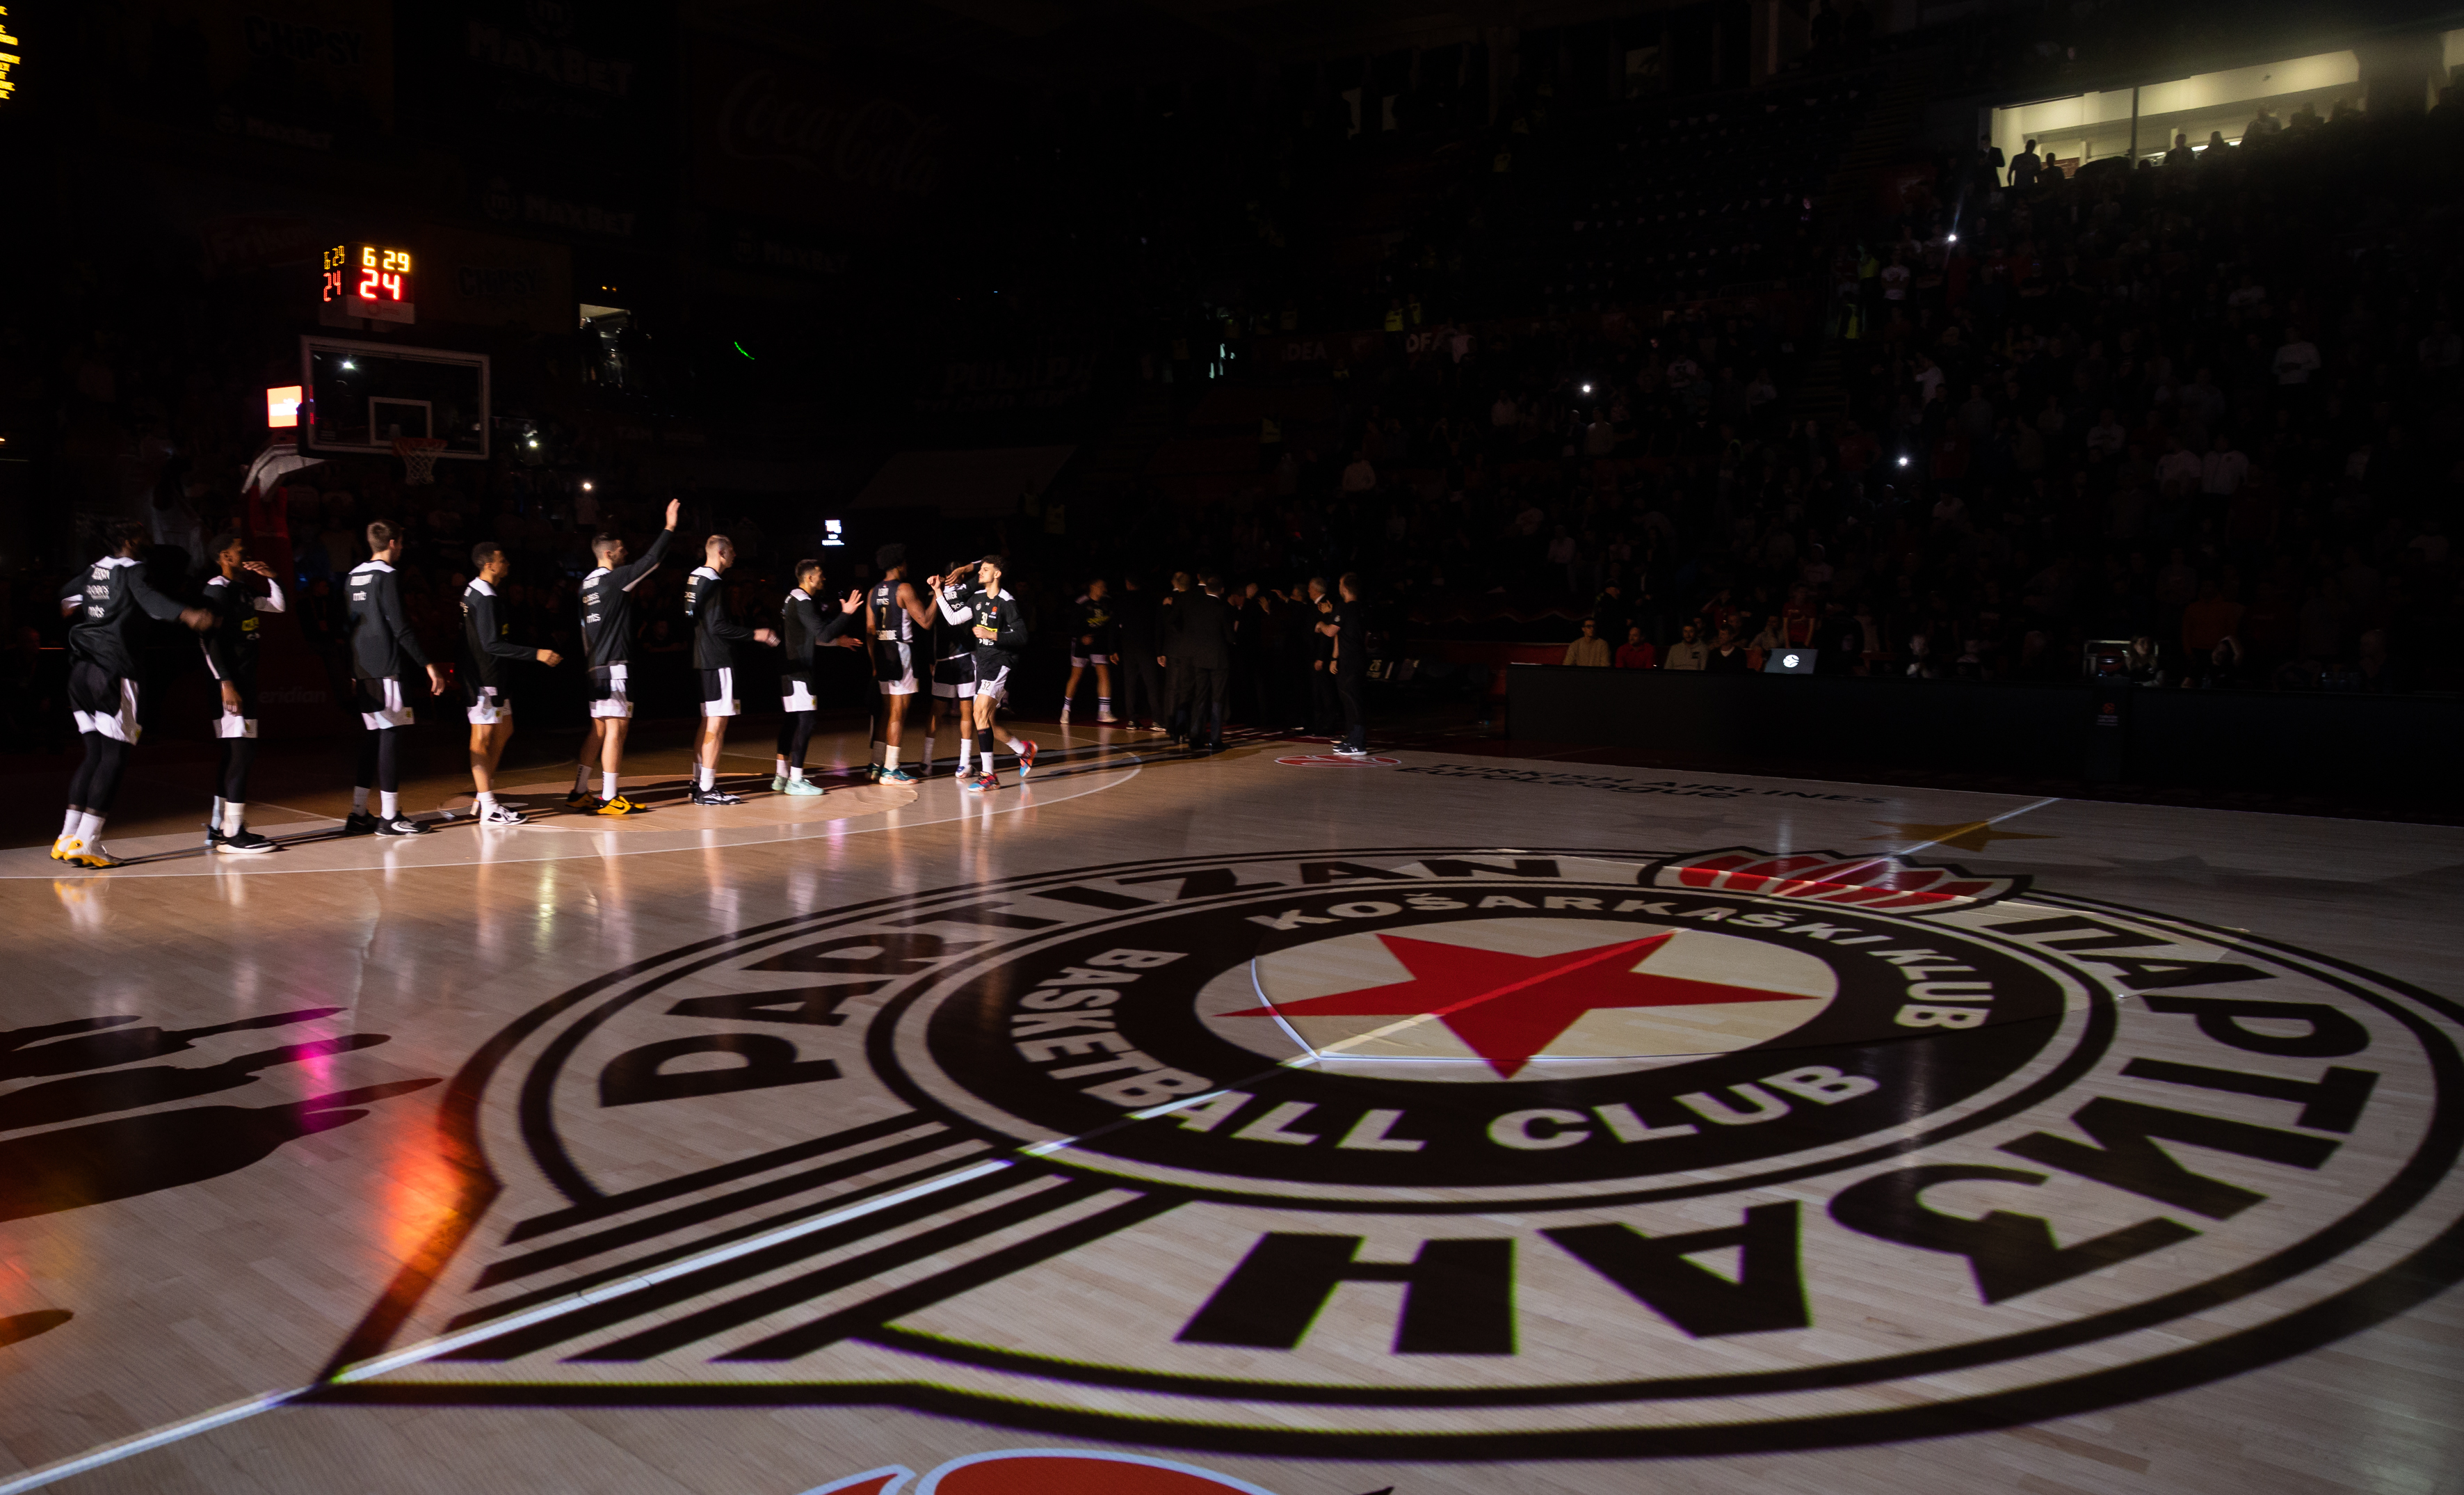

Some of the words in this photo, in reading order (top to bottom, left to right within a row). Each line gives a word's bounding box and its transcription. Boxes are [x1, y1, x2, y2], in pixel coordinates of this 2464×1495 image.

[716, 67, 949, 198] Coca-Cola
[323, 270, 341, 302] 24
[360, 268, 401, 300] 24
[363, 246, 376, 267] 6
[383, 250, 410, 272] 29
[1641, 781, 1893, 804] AIRLINES
[599, 856, 1561, 1108] PARTIZAN
[1245, 891, 1895, 946] KOŠARKAŠKI
[1865, 948, 1996, 1030] KLUB
[1008, 946, 1427, 1152] BASKETBALL
[1485, 1061, 1882, 1152] CLUB
[1173, 915, 2381, 1356] ПАРТИЗАН
